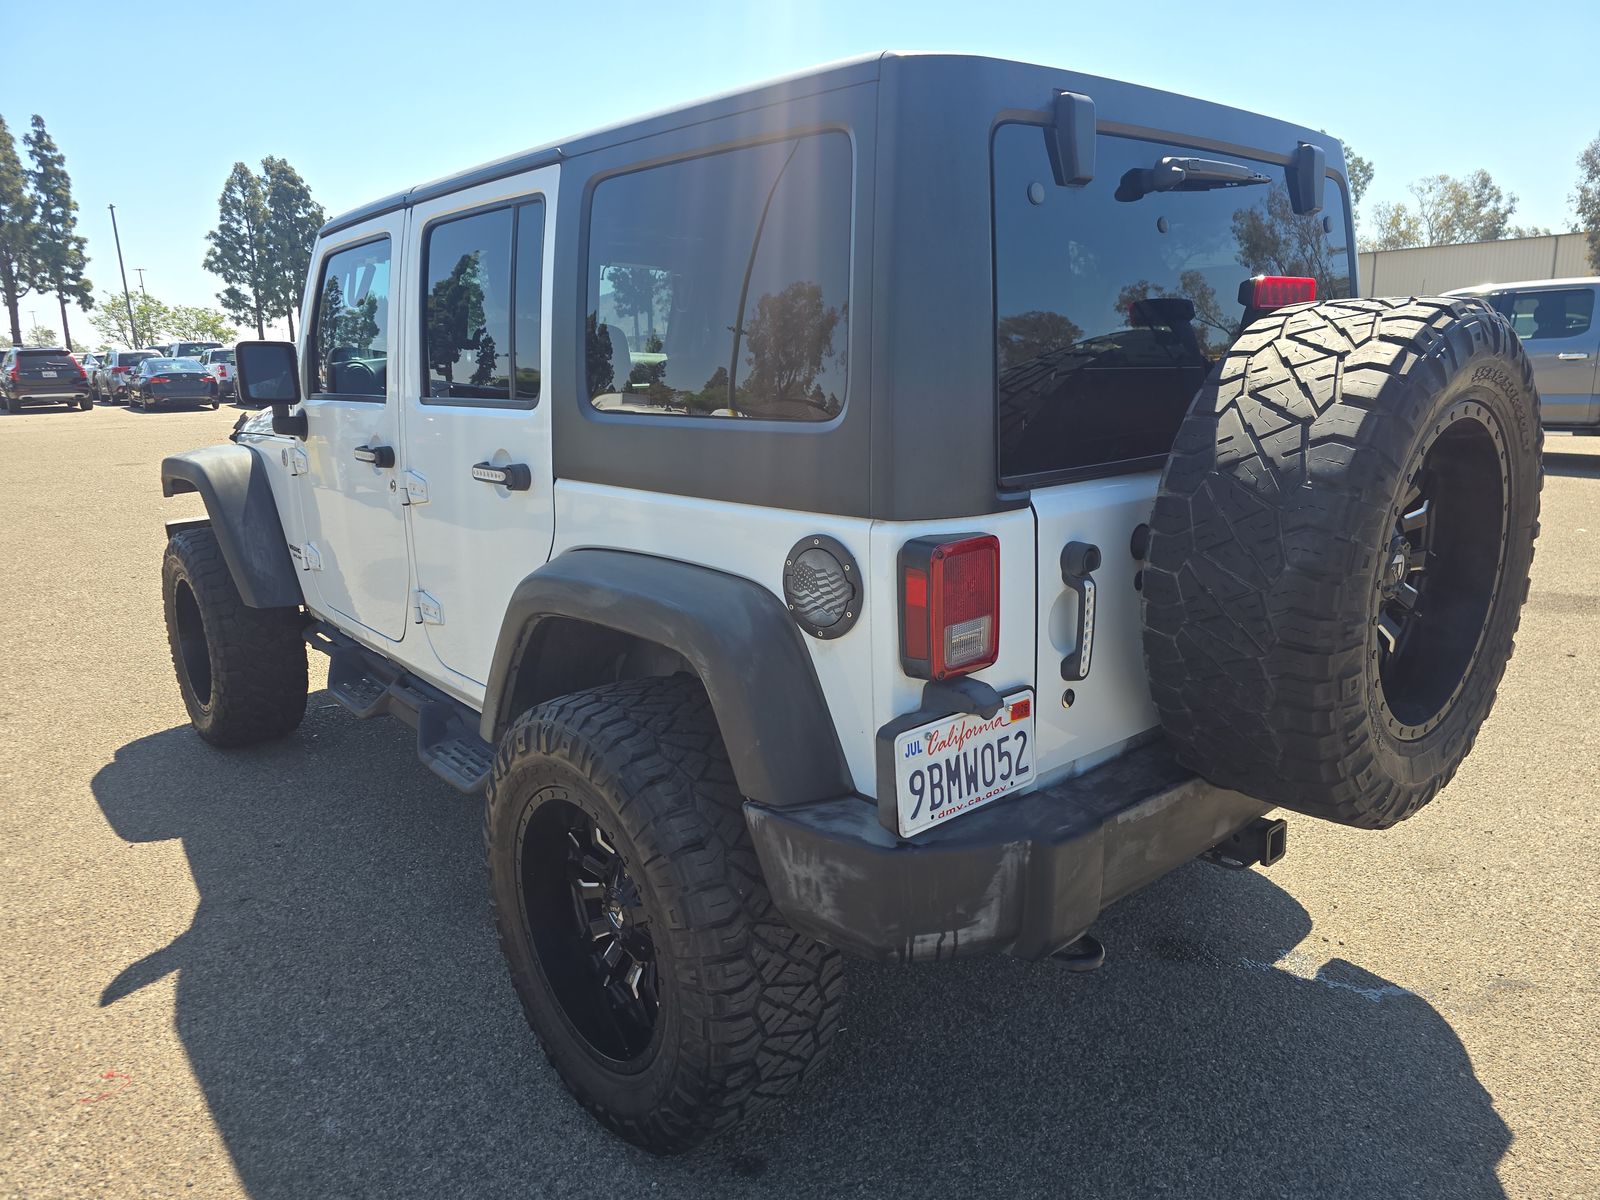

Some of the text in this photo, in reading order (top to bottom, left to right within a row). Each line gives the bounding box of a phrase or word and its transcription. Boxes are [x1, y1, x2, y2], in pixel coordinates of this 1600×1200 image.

[905, 740, 922, 758] JUL
[927, 716, 1011, 756] California
[909, 730, 1029, 820] 9BMW052
[938, 785, 1007, 819] dmv.ca.gov
